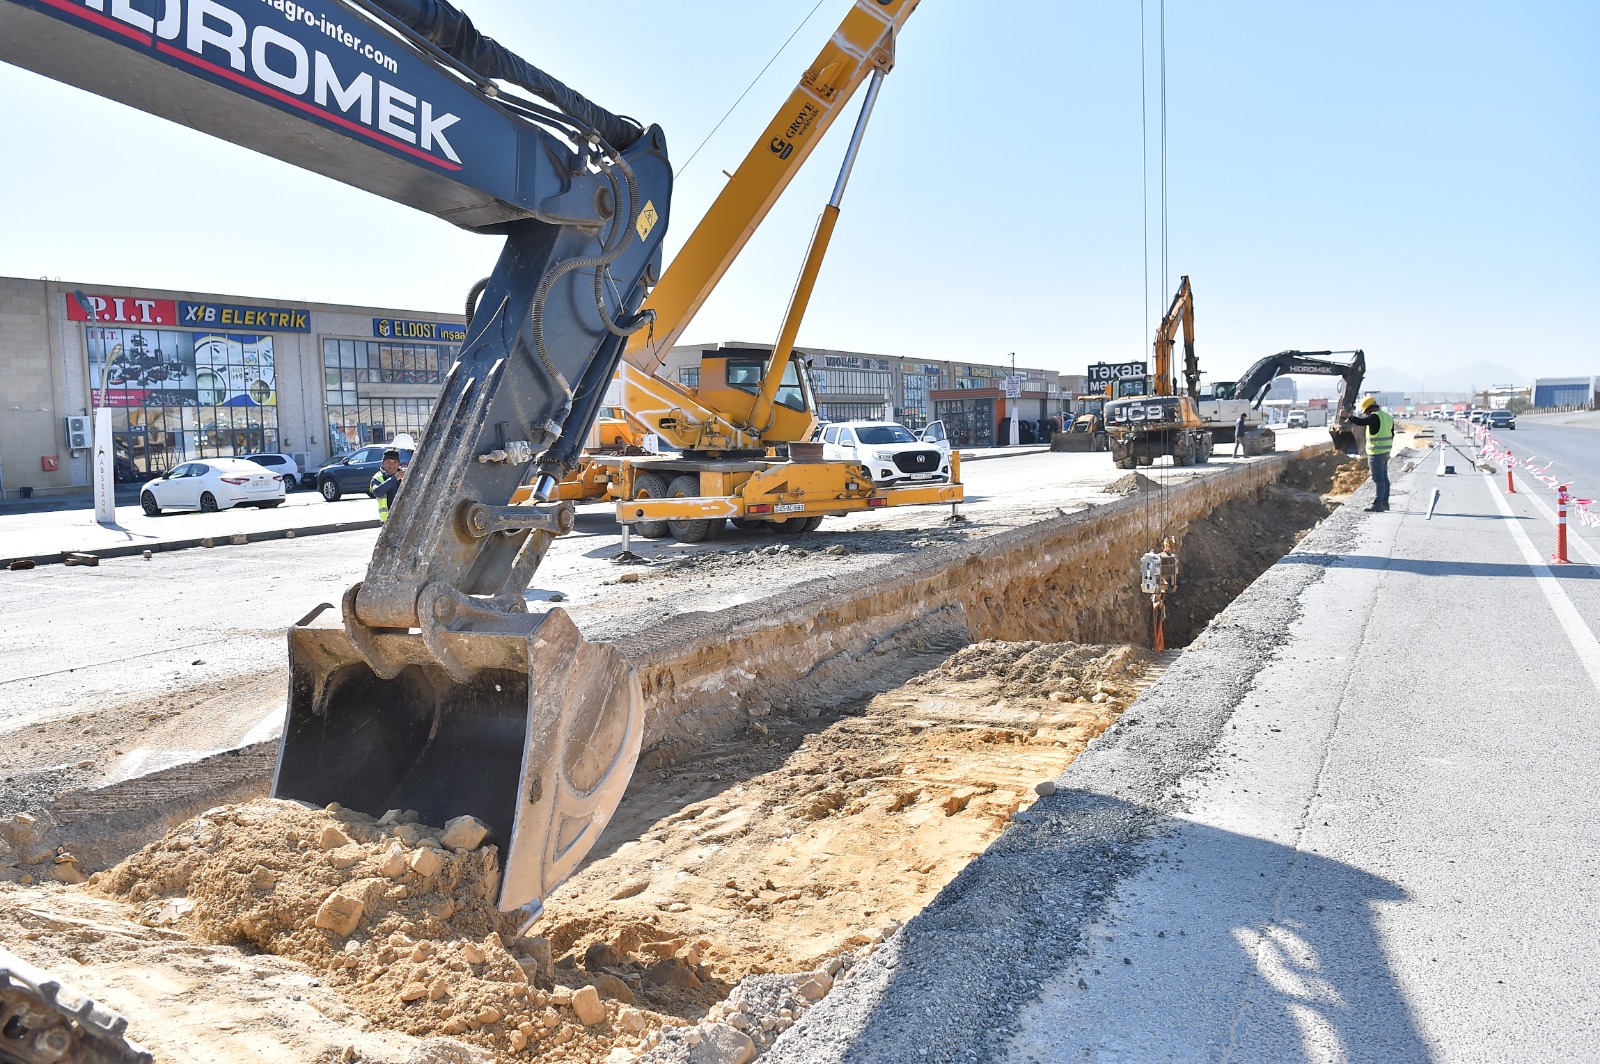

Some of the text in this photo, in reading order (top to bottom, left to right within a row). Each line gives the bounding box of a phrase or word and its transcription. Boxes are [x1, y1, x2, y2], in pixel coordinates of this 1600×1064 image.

[785, 102, 814, 139] GROVE
[87, 297, 162, 323] P.I.T.
[221, 309, 306, 328] ELEKTRİK
[394, 321, 437, 338] ELDOST
[1090, 364, 1143, 379] TƏKƏR
[1115, 405, 1162, 422] JCB
